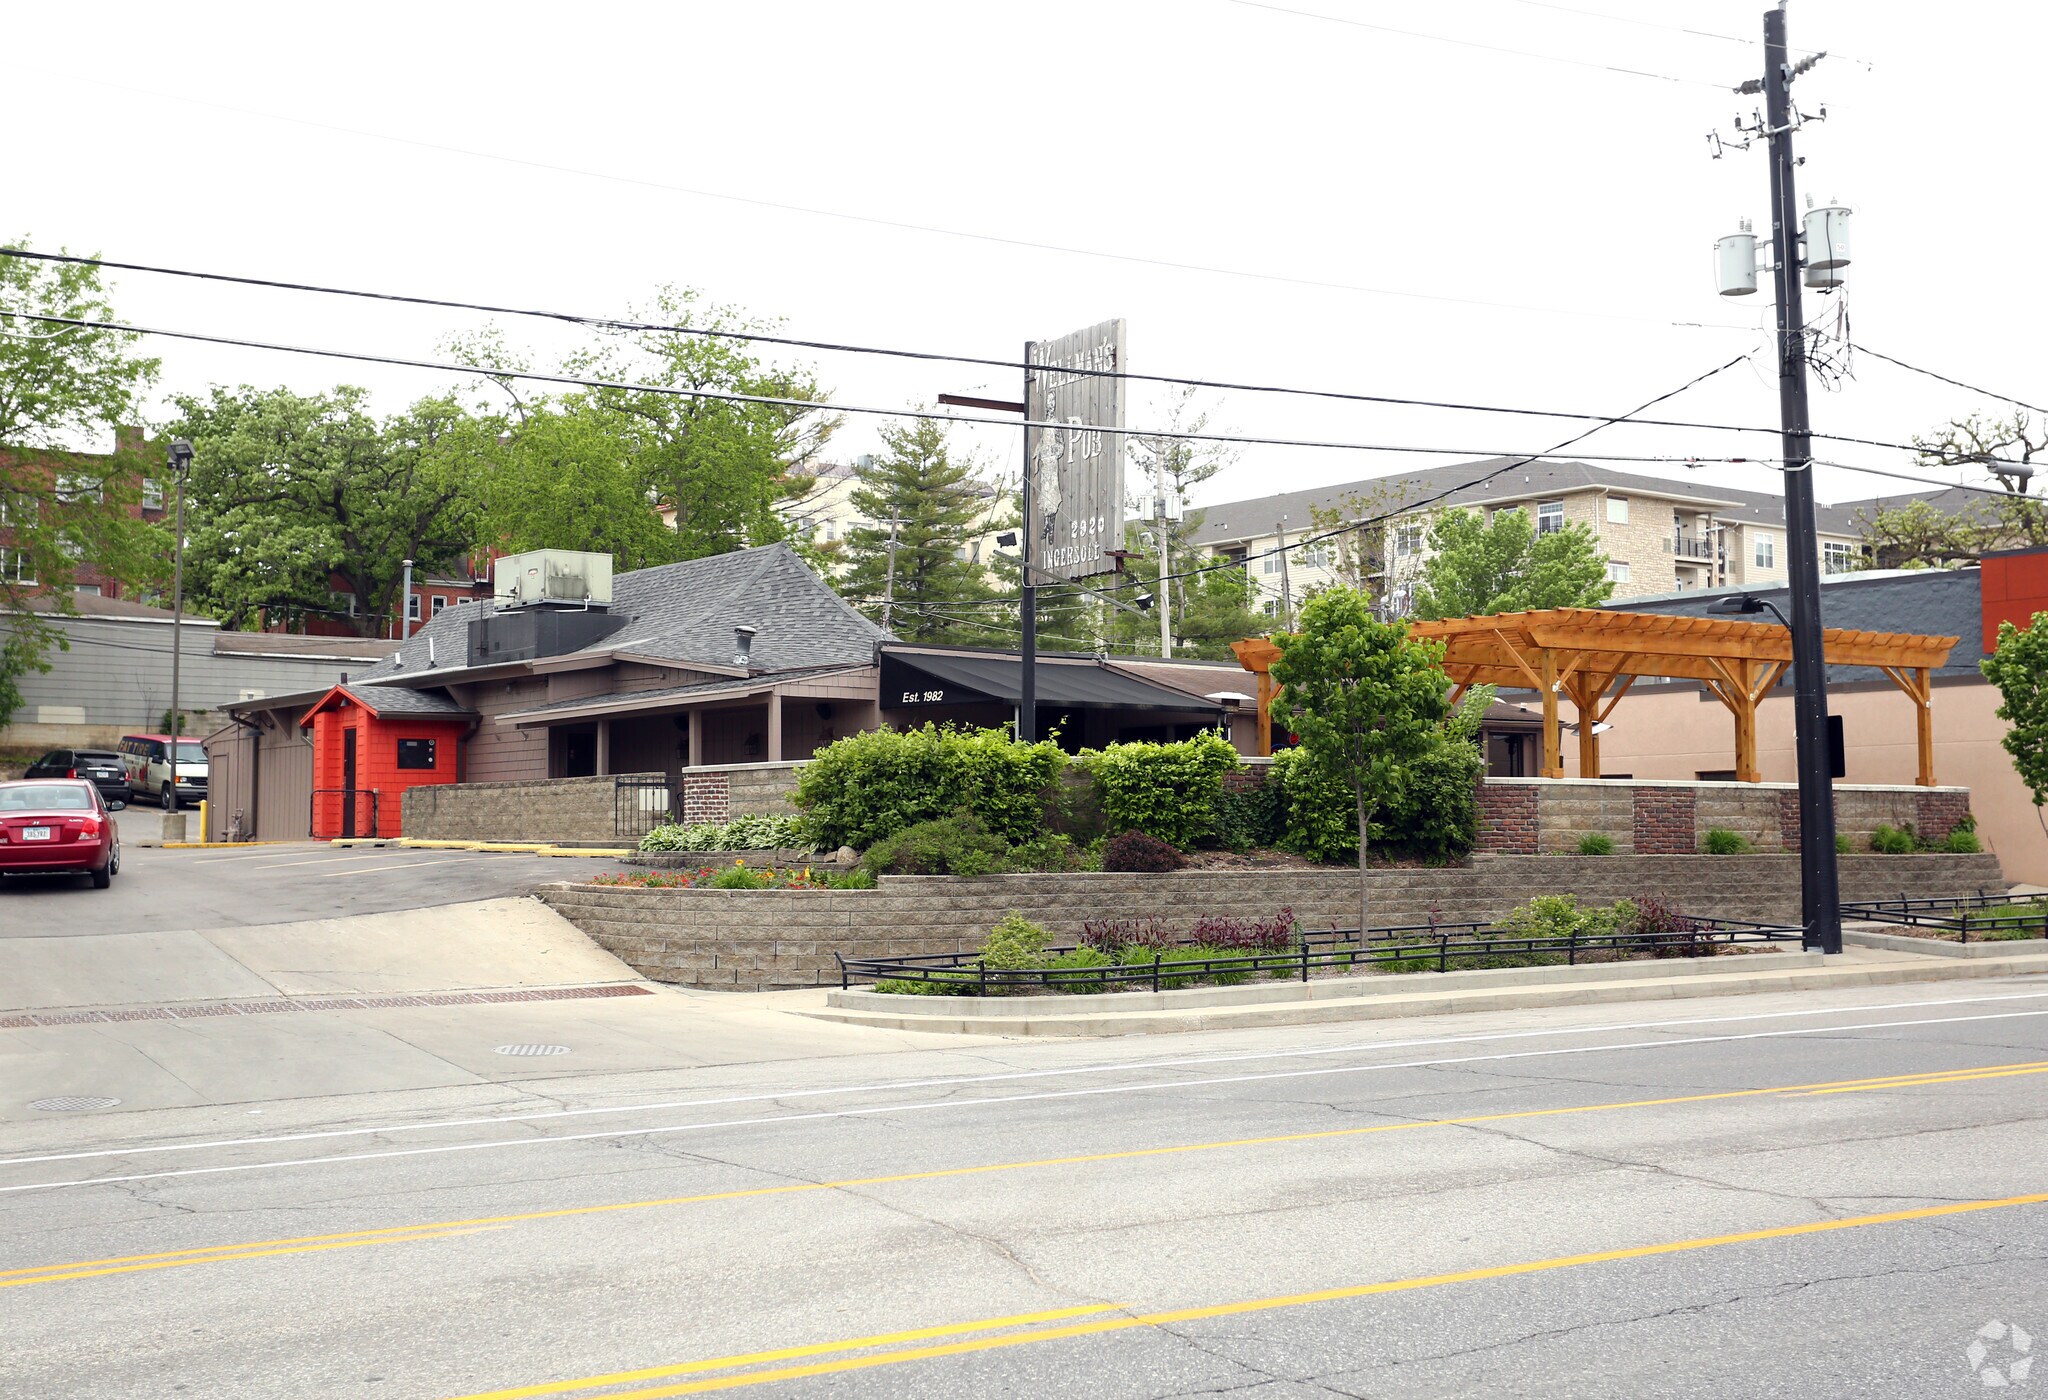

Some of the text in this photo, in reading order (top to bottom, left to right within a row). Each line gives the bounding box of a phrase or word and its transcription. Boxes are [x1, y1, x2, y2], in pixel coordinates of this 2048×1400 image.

[1071, 516, 1105, 539] 2920
[1043, 541, 1100, 570] INGERSOLL
[902, 690, 943, 702] Est. 1982
[119, 740, 149, 756] FAT TIRE
